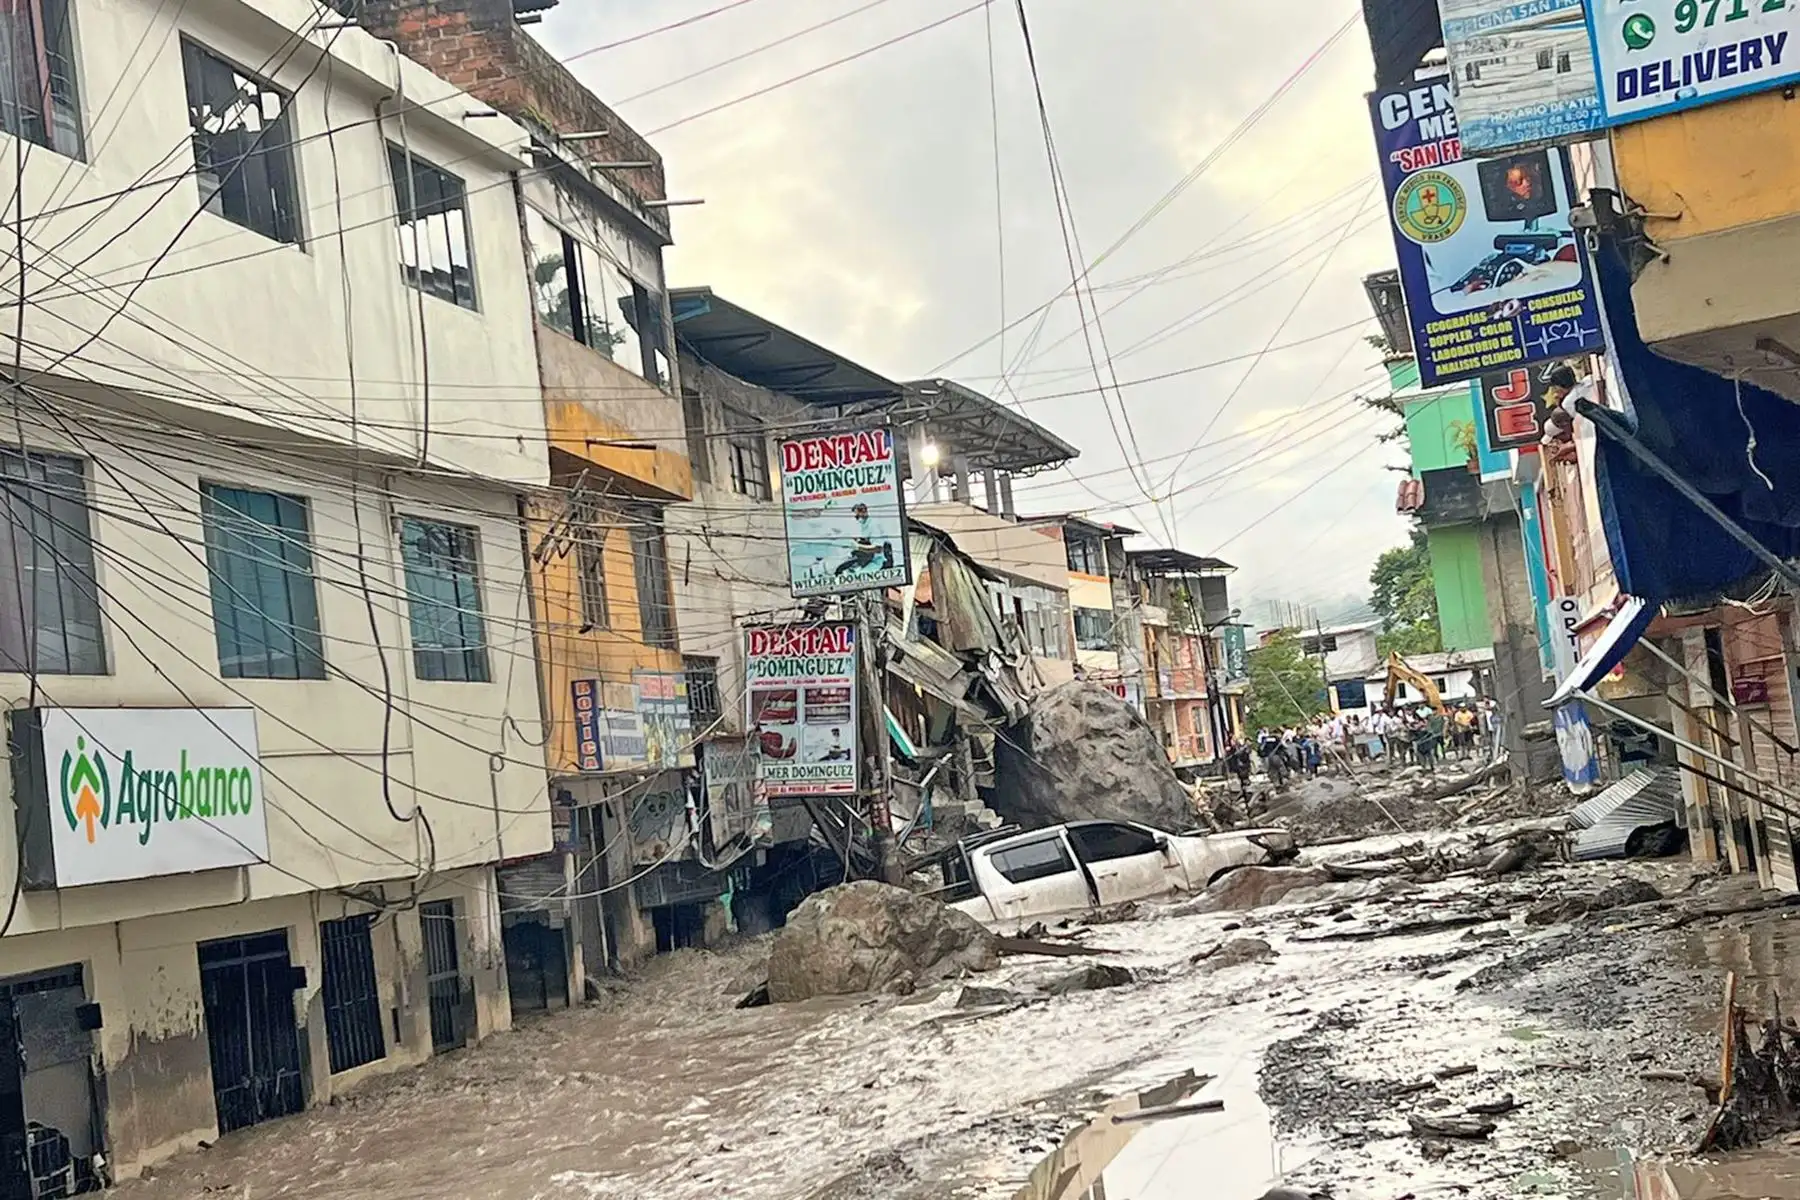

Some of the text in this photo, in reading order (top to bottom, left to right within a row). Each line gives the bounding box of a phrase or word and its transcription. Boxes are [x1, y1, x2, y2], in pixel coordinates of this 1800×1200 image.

[1518, 1, 1550, 18] SAN
[1616, 31, 1789, 103] DELIVERY
[1418, 109, 1458, 141] MÉ
[1490, 104, 1547, 123] HORARIO
[1550, 101, 1565, 112] DE
[1549, 114, 1563, 124] de
[1527, 289, 1585, 312] CONSULTAS
[1530, 305, 1583, 326] FARMACIA
[1429, 321, 1513, 348] DOPPLER COLOR
[1432, 334, 1514, 363] LABORATORIO DE
[783, 430, 891, 472] DENTAL
[794, 569, 903, 590] WILMER DOMINGUEZ
[750, 627, 854, 657] DENTAL
[575, 681, 600, 770] BOTICA
[791, 765, 854, 778] DOMINGUEZ
[115, 750, 253, 846] Agrobanco
